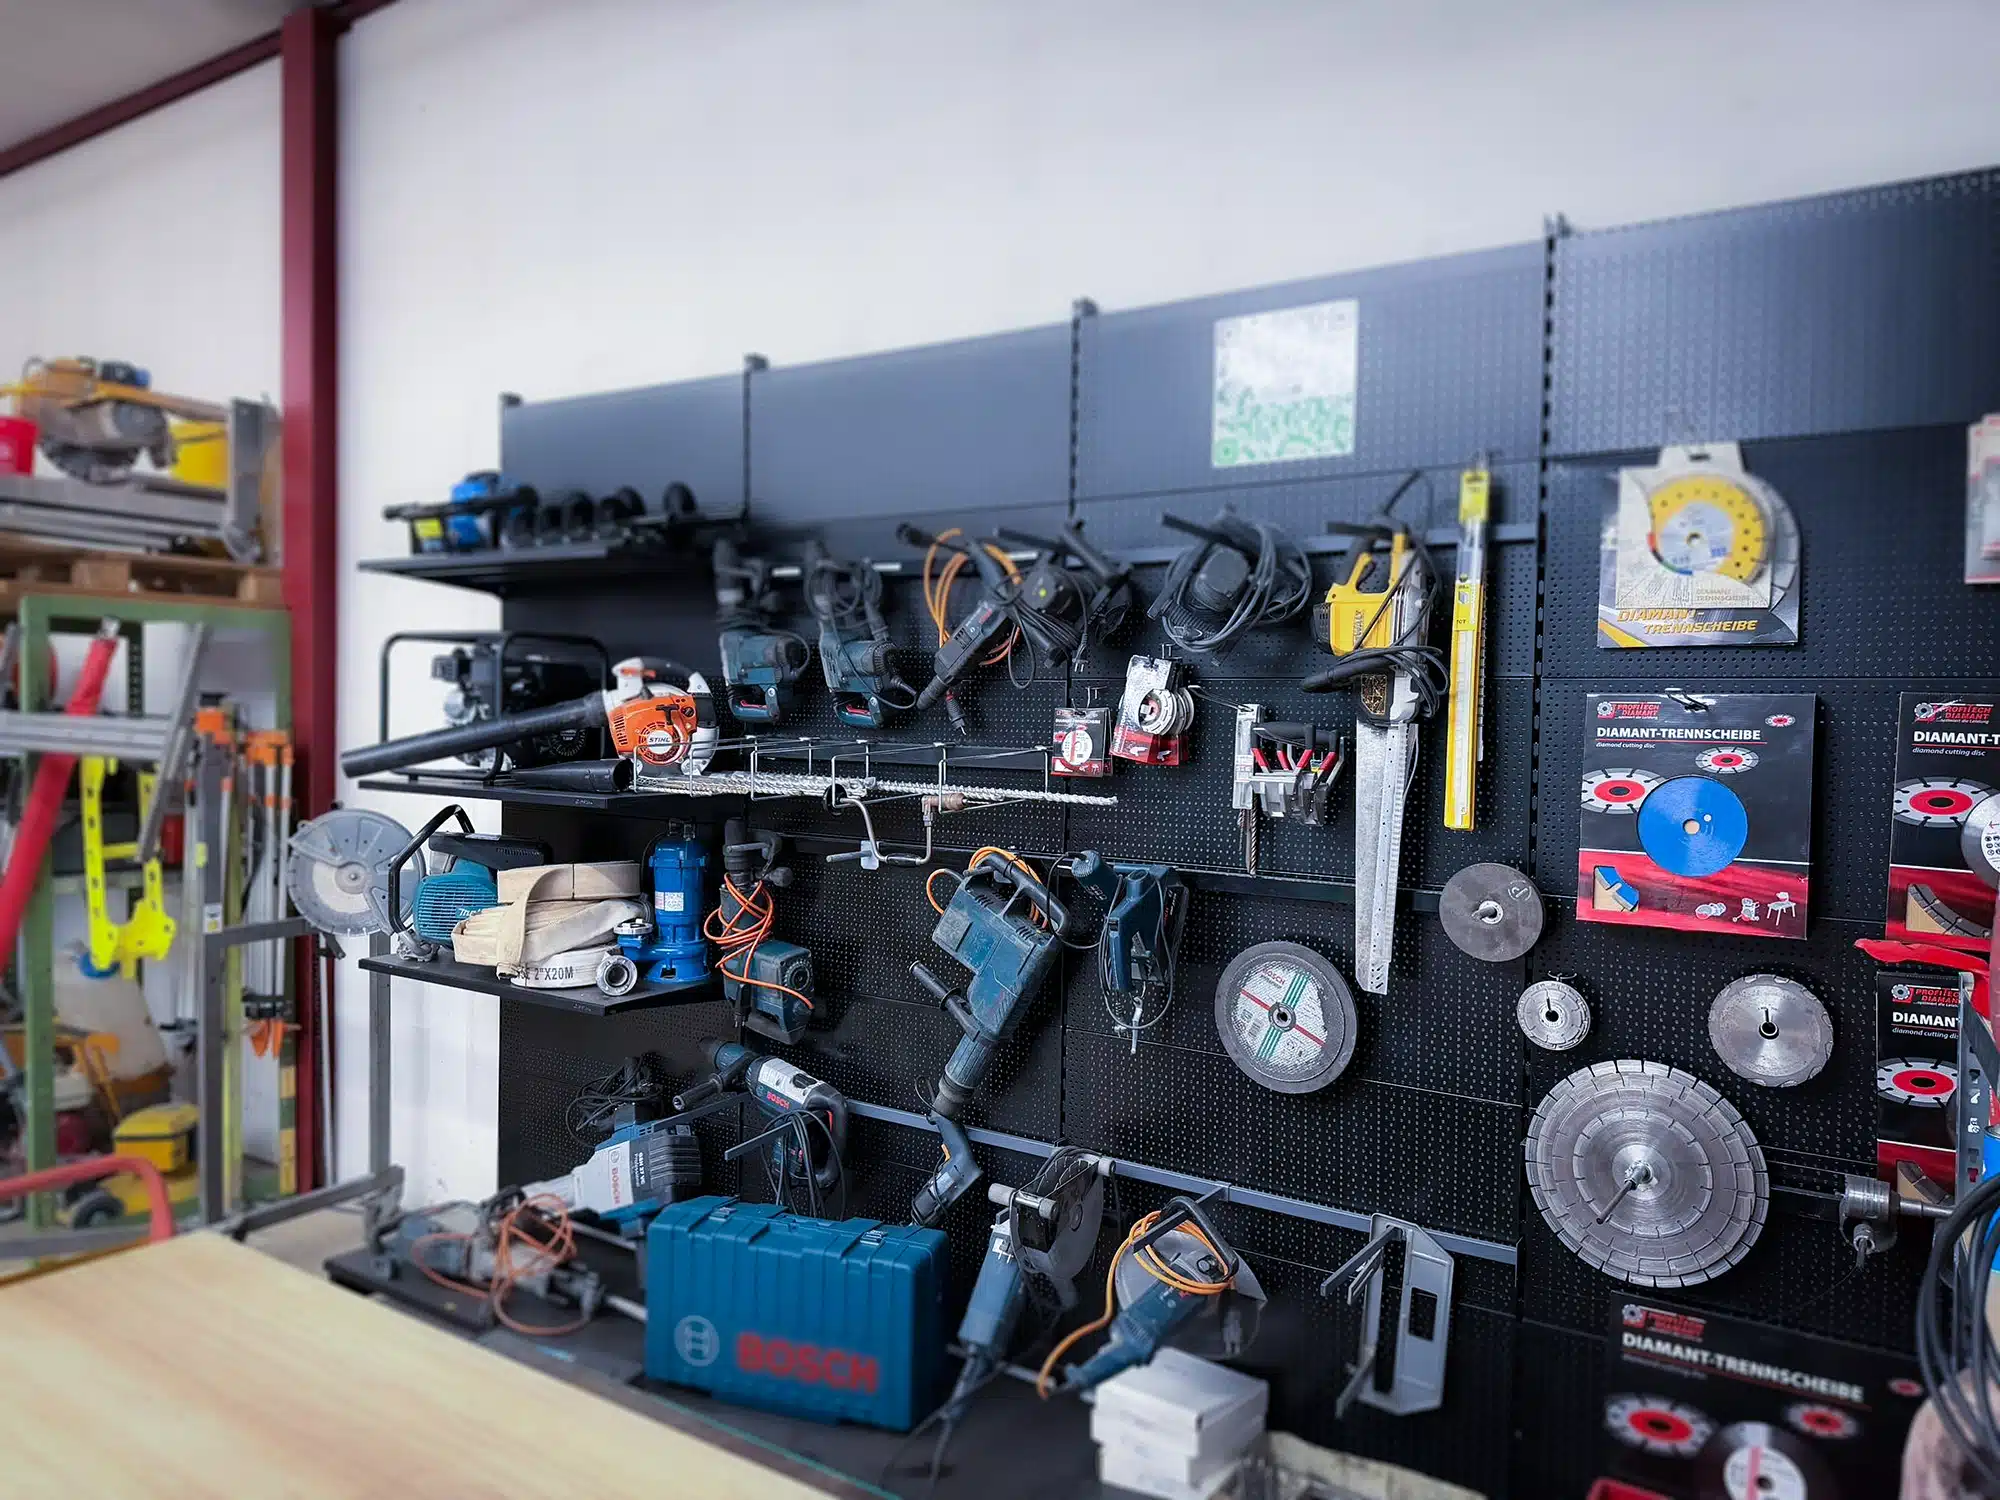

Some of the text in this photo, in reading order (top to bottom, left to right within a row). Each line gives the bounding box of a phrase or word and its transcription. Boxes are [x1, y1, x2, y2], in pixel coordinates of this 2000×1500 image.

[1644, 619, 1758, 634] TRENNSCHEIBE
[1942, 704, 1992, 713] ROFITECH
[1945, 712, 1990, 720] DIAMANT
[1596, 727, 1761, 740] DIAMANT-TRENNSCHEIBE
[1912, 747, 1986, 757] diamond cutting disc
[534, 966, 574, 981] 2"X20M
[1921, 995, 1960, 1004] DIAMAN
[1892, 1028, 1924, 1036] diamond
[1924, 1031, 1949, 1039] cutting
[766, 1091, 790, 1110] BOSCH
[611, 1167, 621, 1205] BOSCH
[736, 1331, 880, 1394] BOSCH
[1623, 1332, 1864, 1402] DIAMANT-TRENNSCHEIBE
